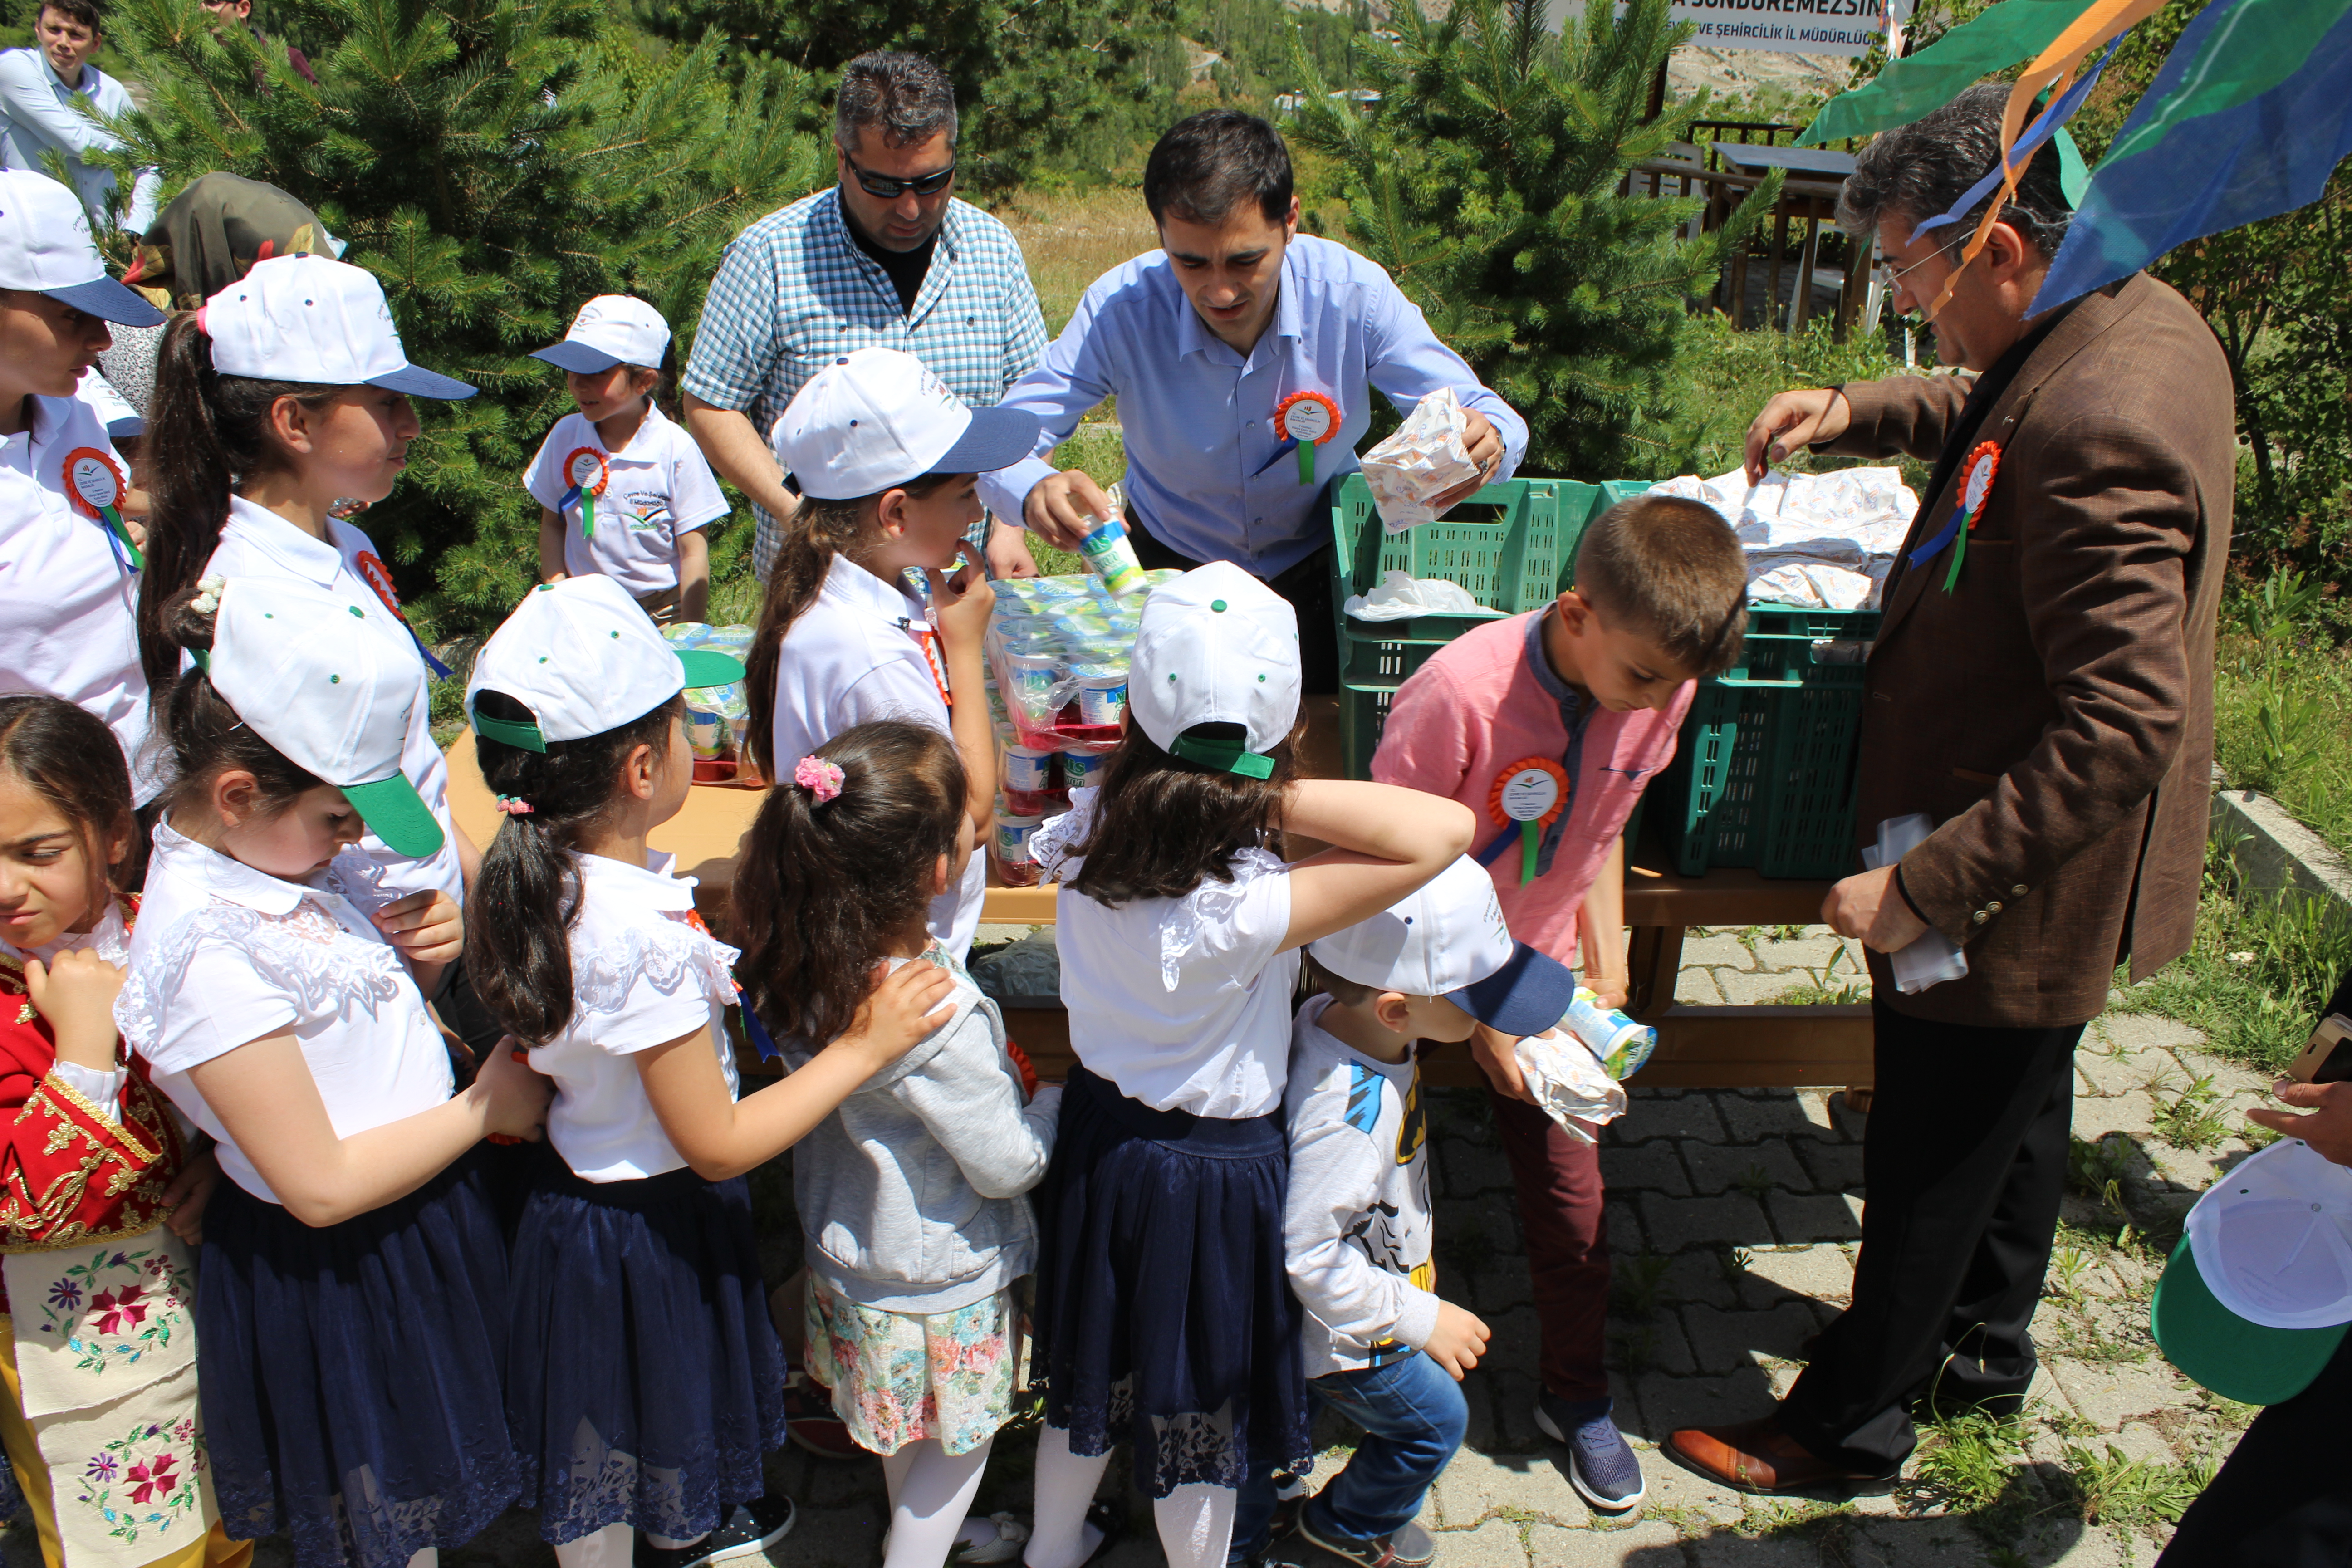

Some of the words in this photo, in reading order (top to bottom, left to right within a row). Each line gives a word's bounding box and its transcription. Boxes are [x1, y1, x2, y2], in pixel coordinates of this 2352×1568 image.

[1699, 22, 1713, 34] VE
[1716, 21, 1782, 39] ŞEHİRCİLİK
[1785, 24, 1796, 40] İL
